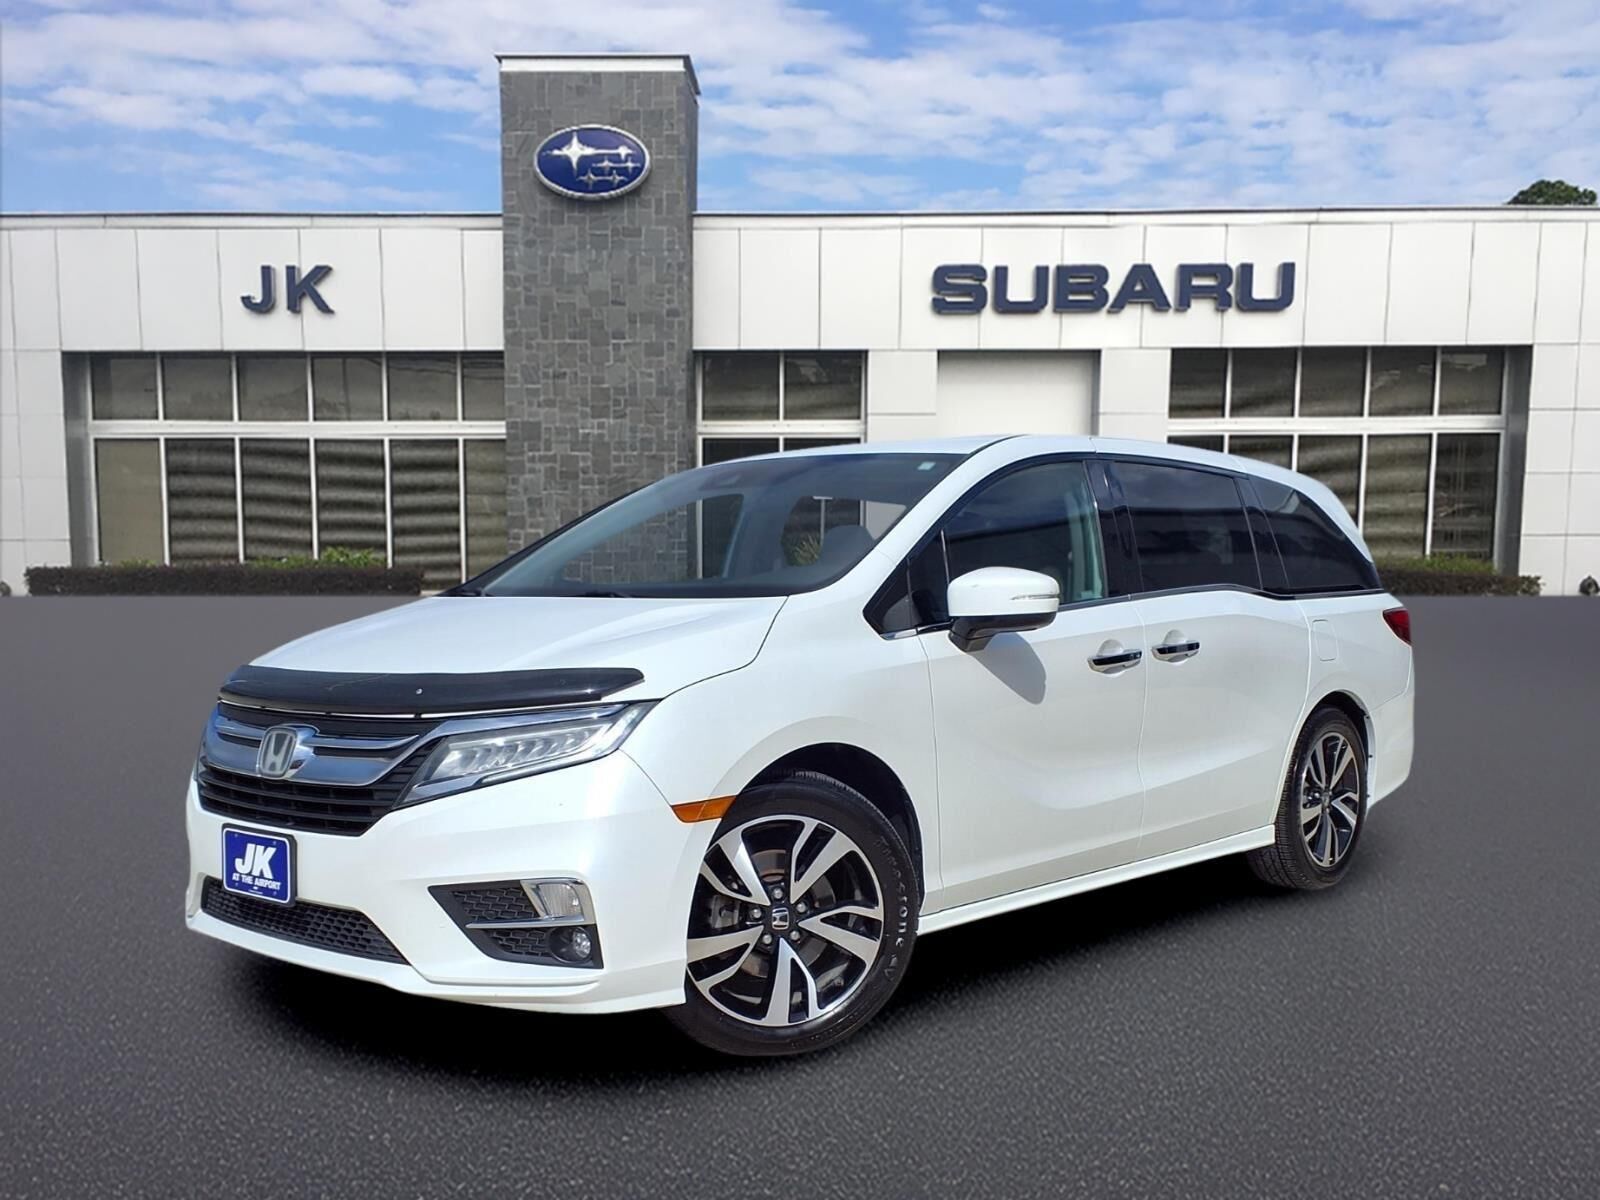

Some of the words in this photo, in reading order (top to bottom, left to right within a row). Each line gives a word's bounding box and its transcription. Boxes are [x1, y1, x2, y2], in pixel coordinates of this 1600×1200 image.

[240, 264, 335, 314] JK
[931, 262, 1296, 314] SUBARU
[232, 872, 240, 881] AT
[241, 874, 254, 885] THE
[254, 877, 281, 890] AIRPORT
[235, 843, 277, 879] JK
